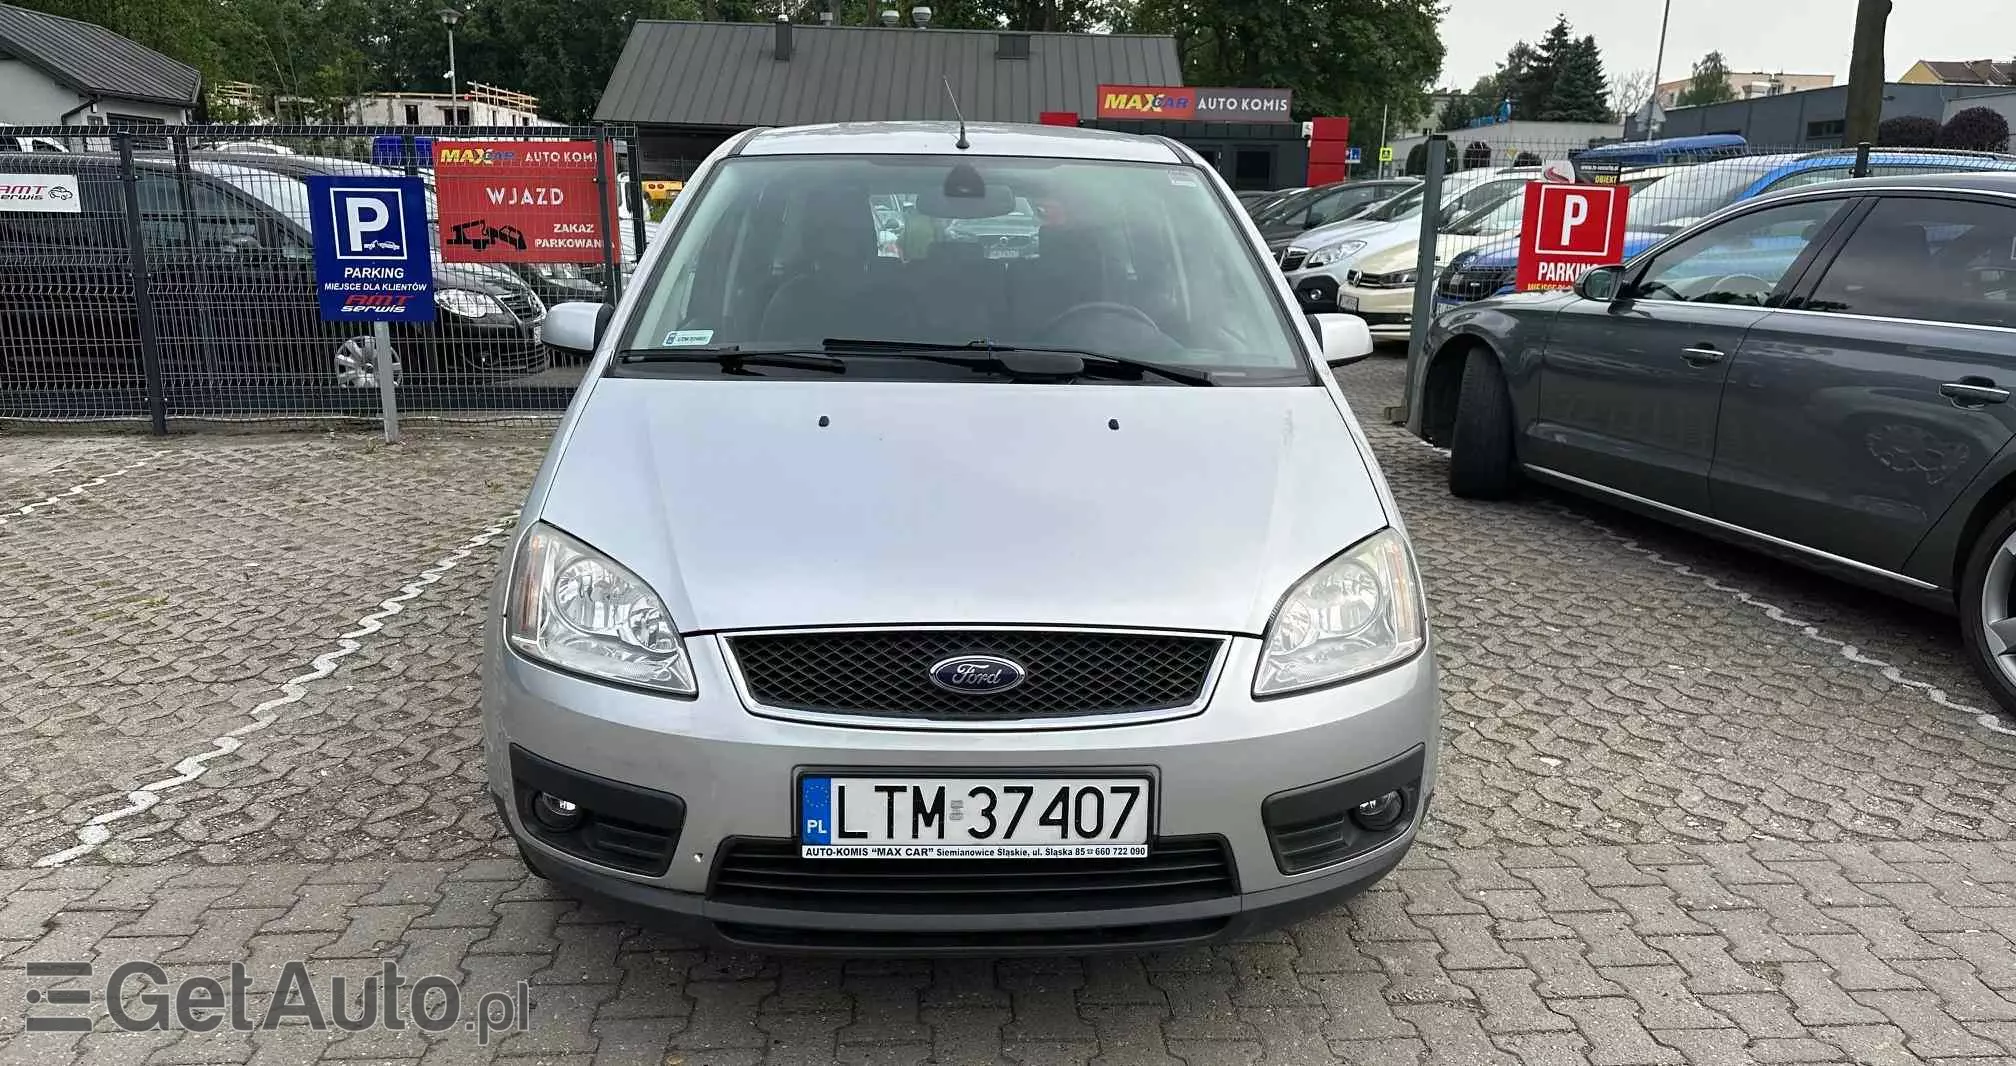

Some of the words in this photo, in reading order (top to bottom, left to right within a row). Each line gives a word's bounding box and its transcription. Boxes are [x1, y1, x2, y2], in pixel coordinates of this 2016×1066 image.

[1198, 98, 1238, 111] AUTO
[1241, 98, 1288, 112] KOMIS
[525, 151, 560, 162] AUTO
[563, 151, 598, 162] KOMI
[485, 187, 564, 206] WJAZD
[345, 197, 390, 252] P
[1560, 194, 1589, 247] P
[553, 223, 595, 234] ZAKAZ
[534, 238, 616, 249] PARKOWAN
[344, 267, 405, 279] PARKING
[324, 282, 361, 292] MIEJSCE
[362, 282, 380, 292] DLA
[381, 282, 428, 292] KLIENTÓW
[345, 294, 417, 306] AMT
[340, 304, 407, 314] serwis
[951, 663, 1003, 685] Ford
[837, 785, 946, 840] LTM
[967, 785, 1141, 840] 37407
[806, 820, 828, 835] PL
[805, 847, 869, 857] AUTO-KOMIS
[936, 847, 995, 857] Siemianowice
[1032, 847, 1043, 857] ul.
[1075, 847, 1086, 856] 85
[1095, 847, 1111, 856] 660
[1113, 847, 1128, 856] 722
[1130, 847, 1146, 856] 090
